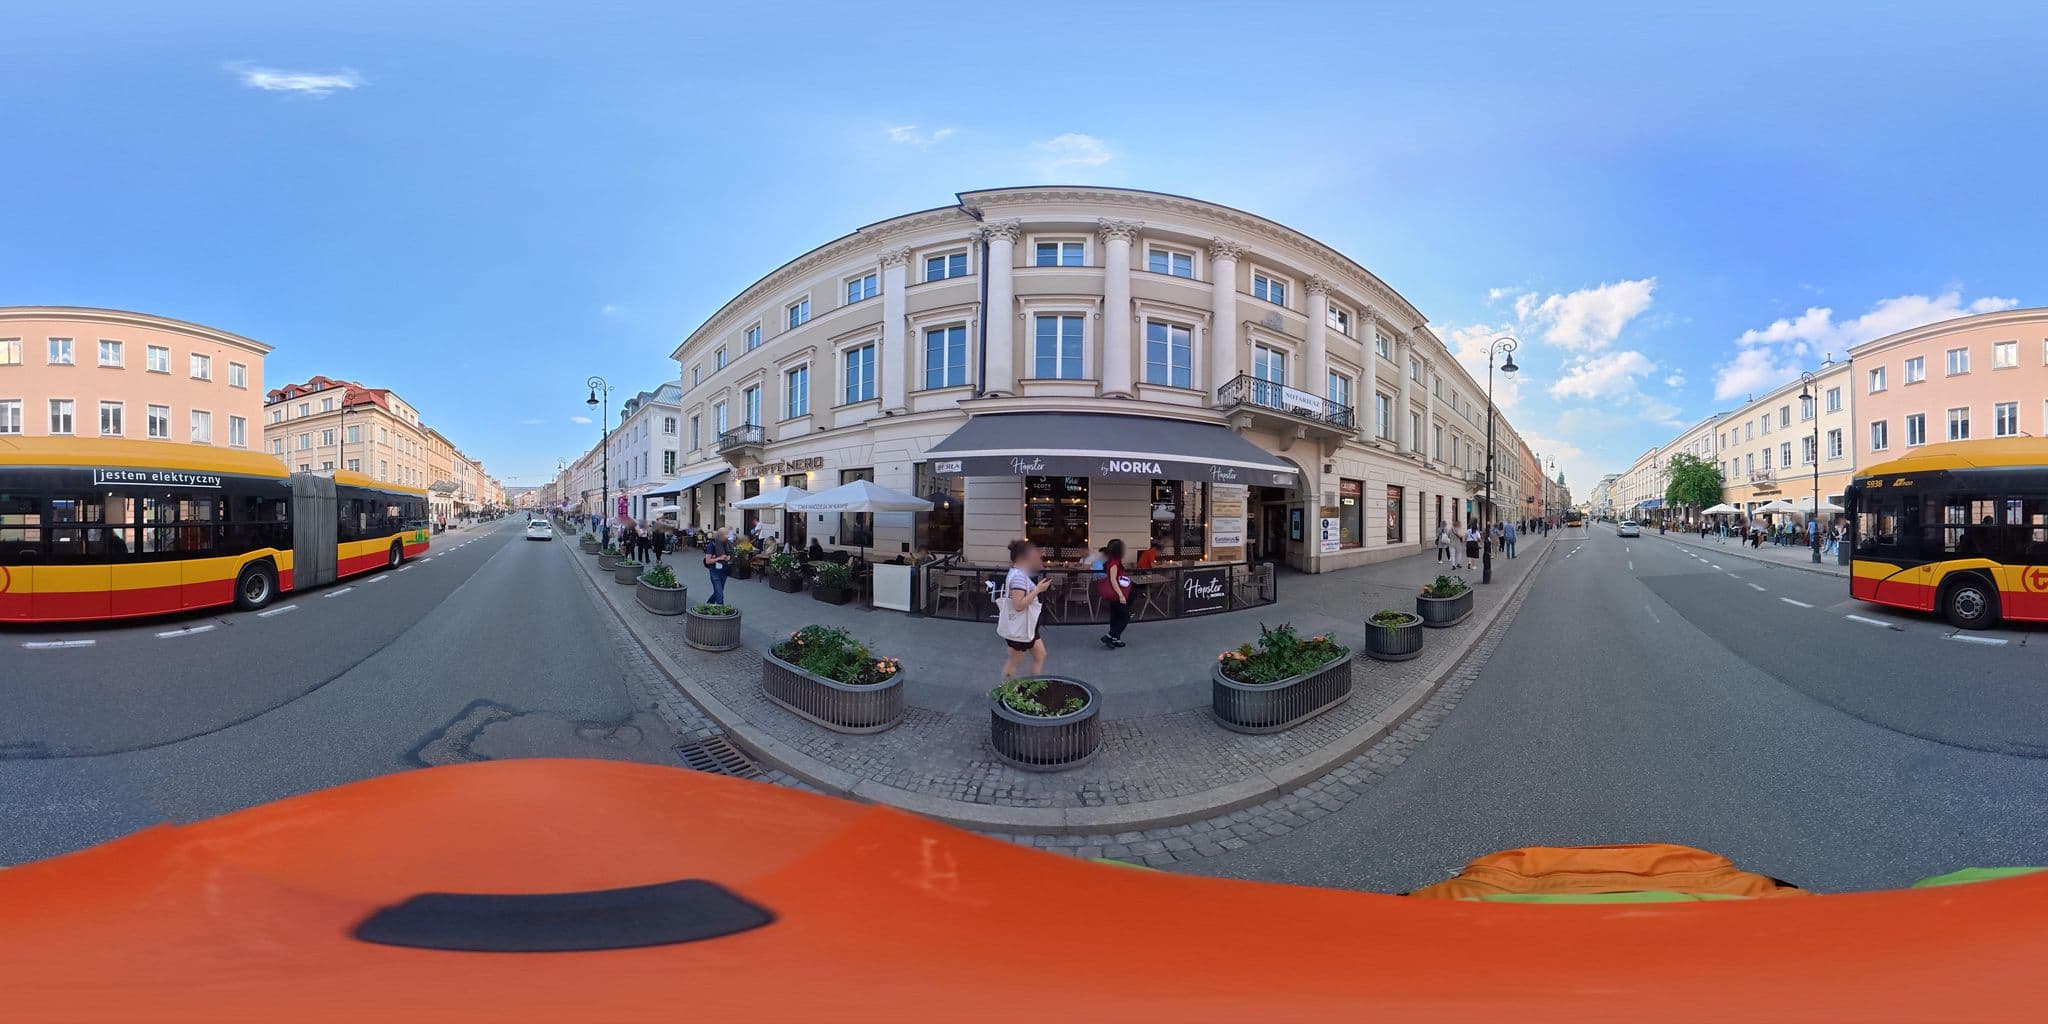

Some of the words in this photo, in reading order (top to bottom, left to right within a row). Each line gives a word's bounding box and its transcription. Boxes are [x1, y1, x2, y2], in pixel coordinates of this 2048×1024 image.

[1285, 392, 1320, 407] NOTARIUSZ
[786, 457, 823, 472] NERO
[1011, 457, 1044, 474] Hopster
[1110, 461, 1162, 474] NORKA
[101, 469, 146, 481] jestem
[152, 472, 221, 486] elektryczny
[1210, 465, 1236, 482] Hopster
[1184, 577, 1223, 599] Hopster
